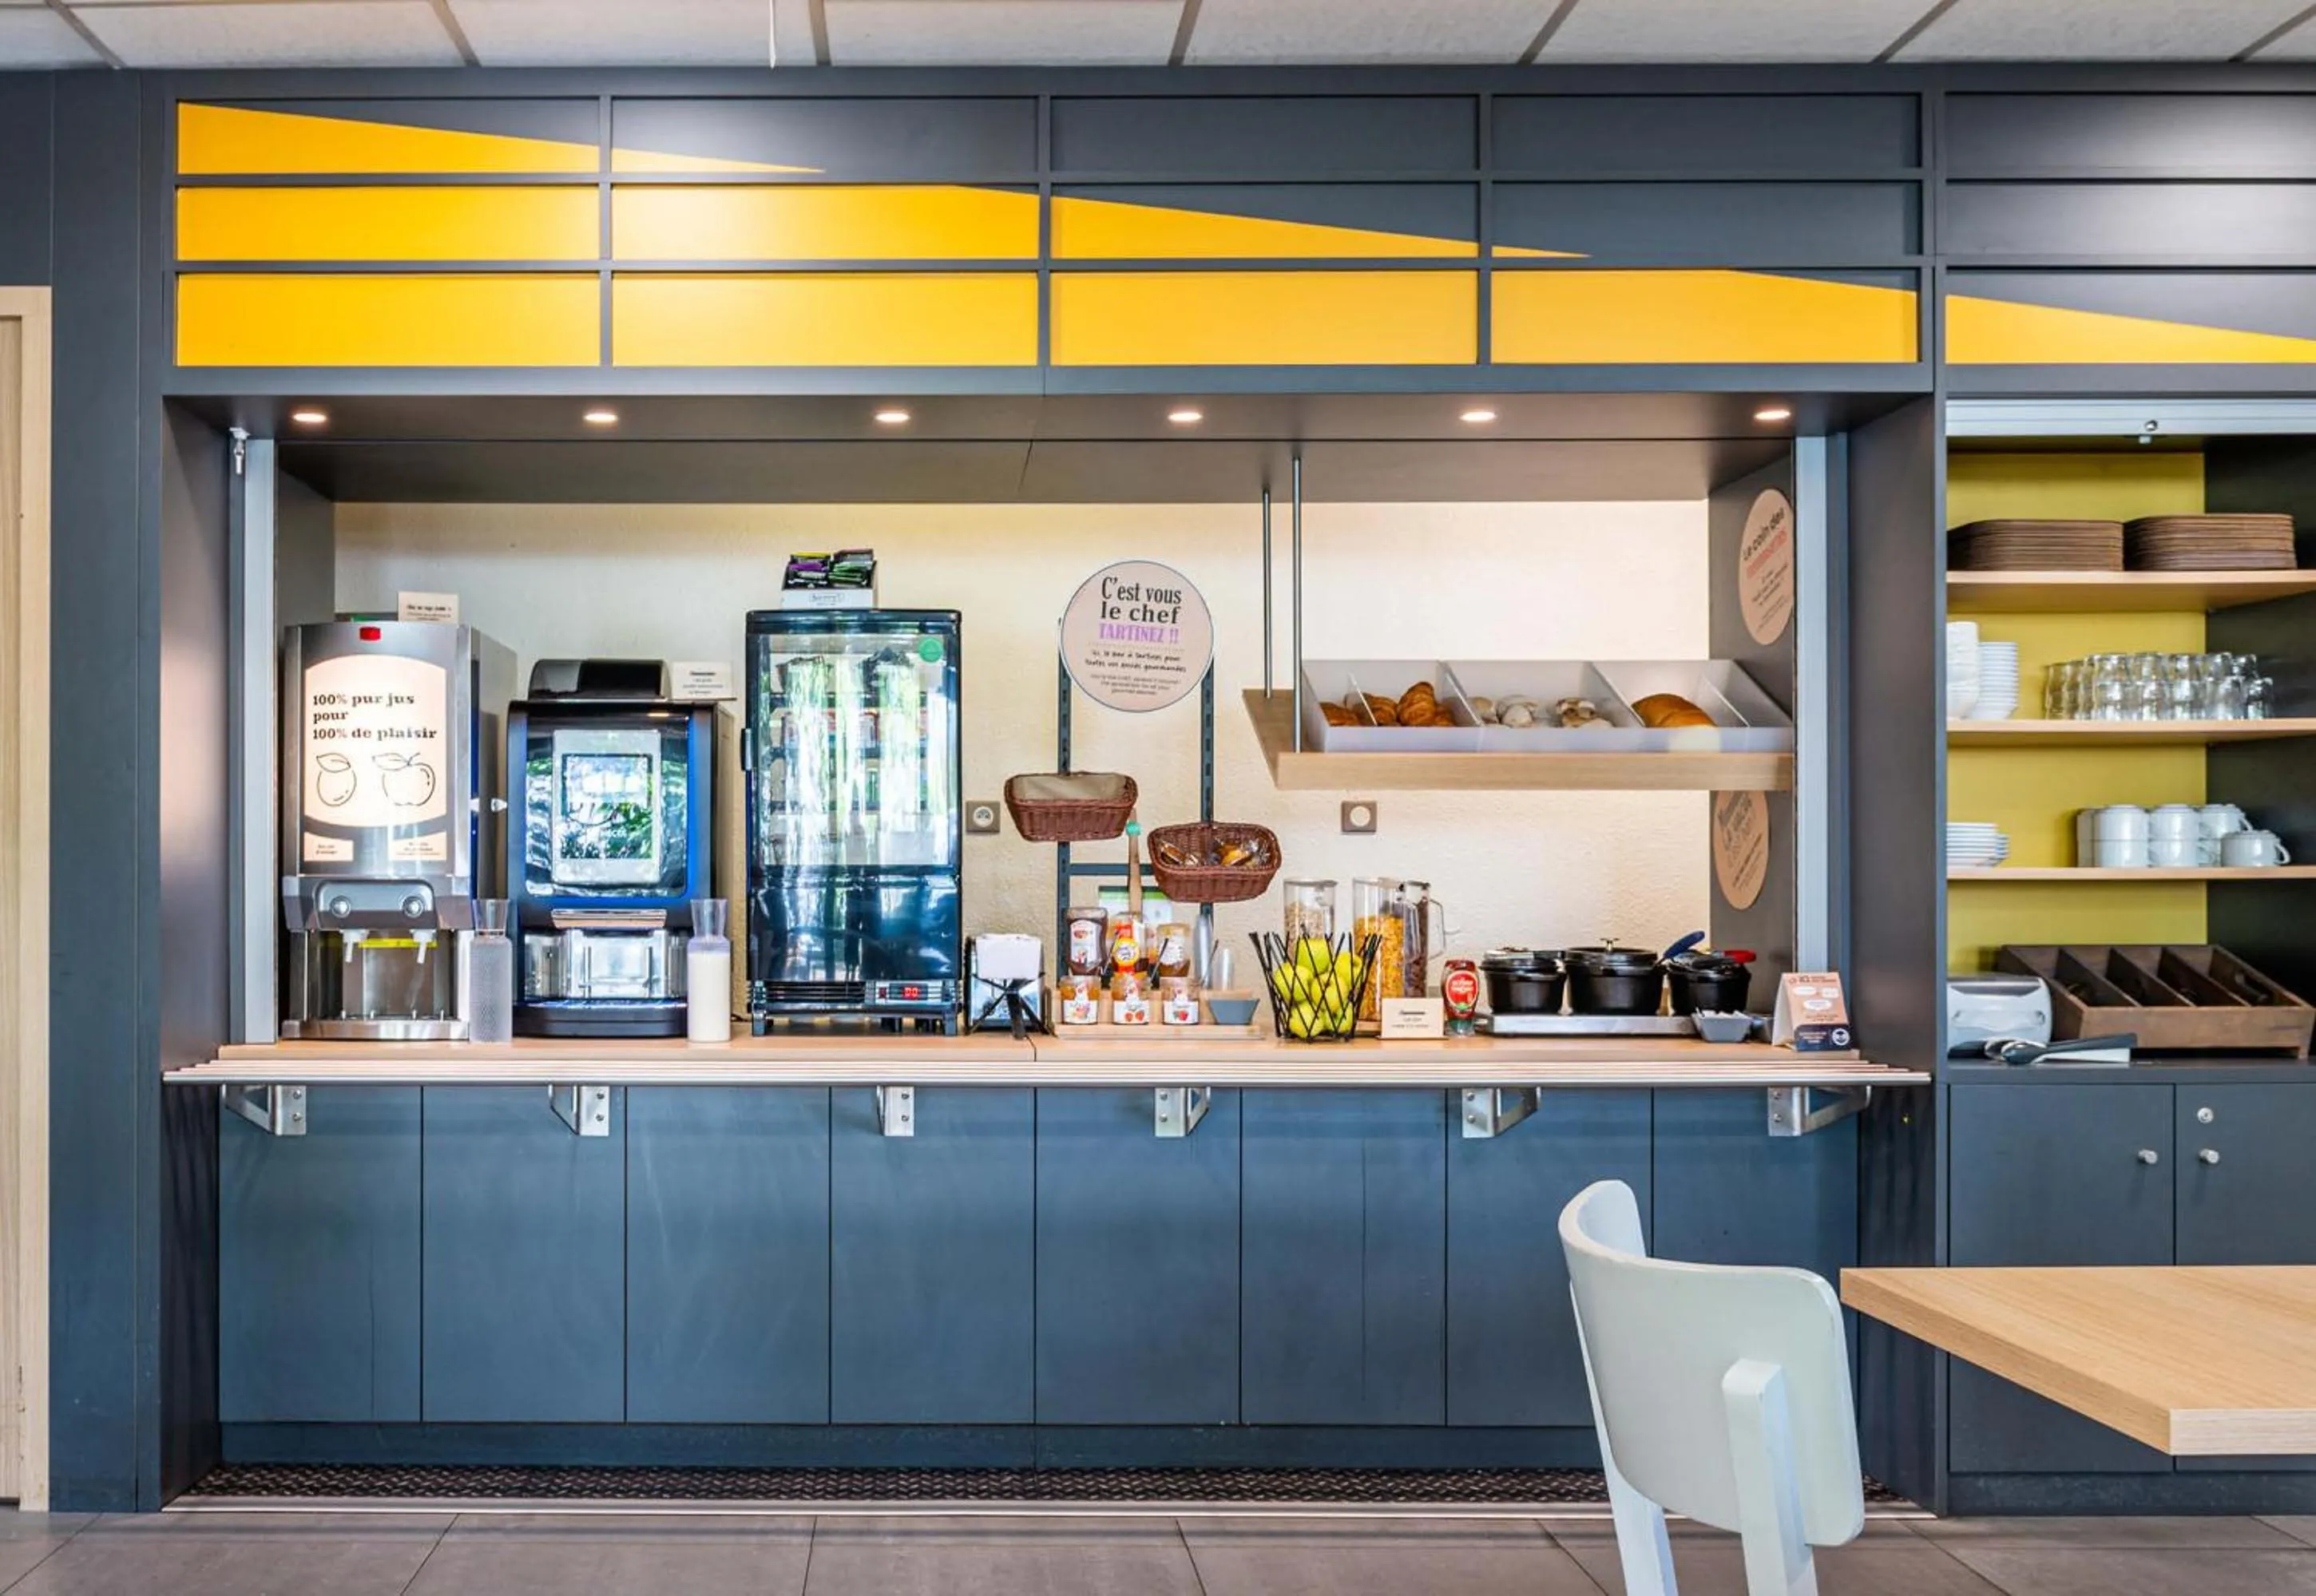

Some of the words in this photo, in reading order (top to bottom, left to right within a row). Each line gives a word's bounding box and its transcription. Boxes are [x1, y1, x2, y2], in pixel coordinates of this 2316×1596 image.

[1101, 576, 1140, 601] C'est
[1146, 588, 1182, 604] vous
[1100, 601, 1121, 620] le
[1129, 604, 1181, 624] chef
[1099, 623, 1164, 644] TARTINEZ
[313, 694, 347, 706] 100%
[351, 695, 383, 707] pur
[386, 693, 414, 707] jus
[313, 711, 348, 724] pour
[313, 727, 347, 739] 100%
[351, 727, 371, 739] de
[377, 727, 438, 741] plaisir
